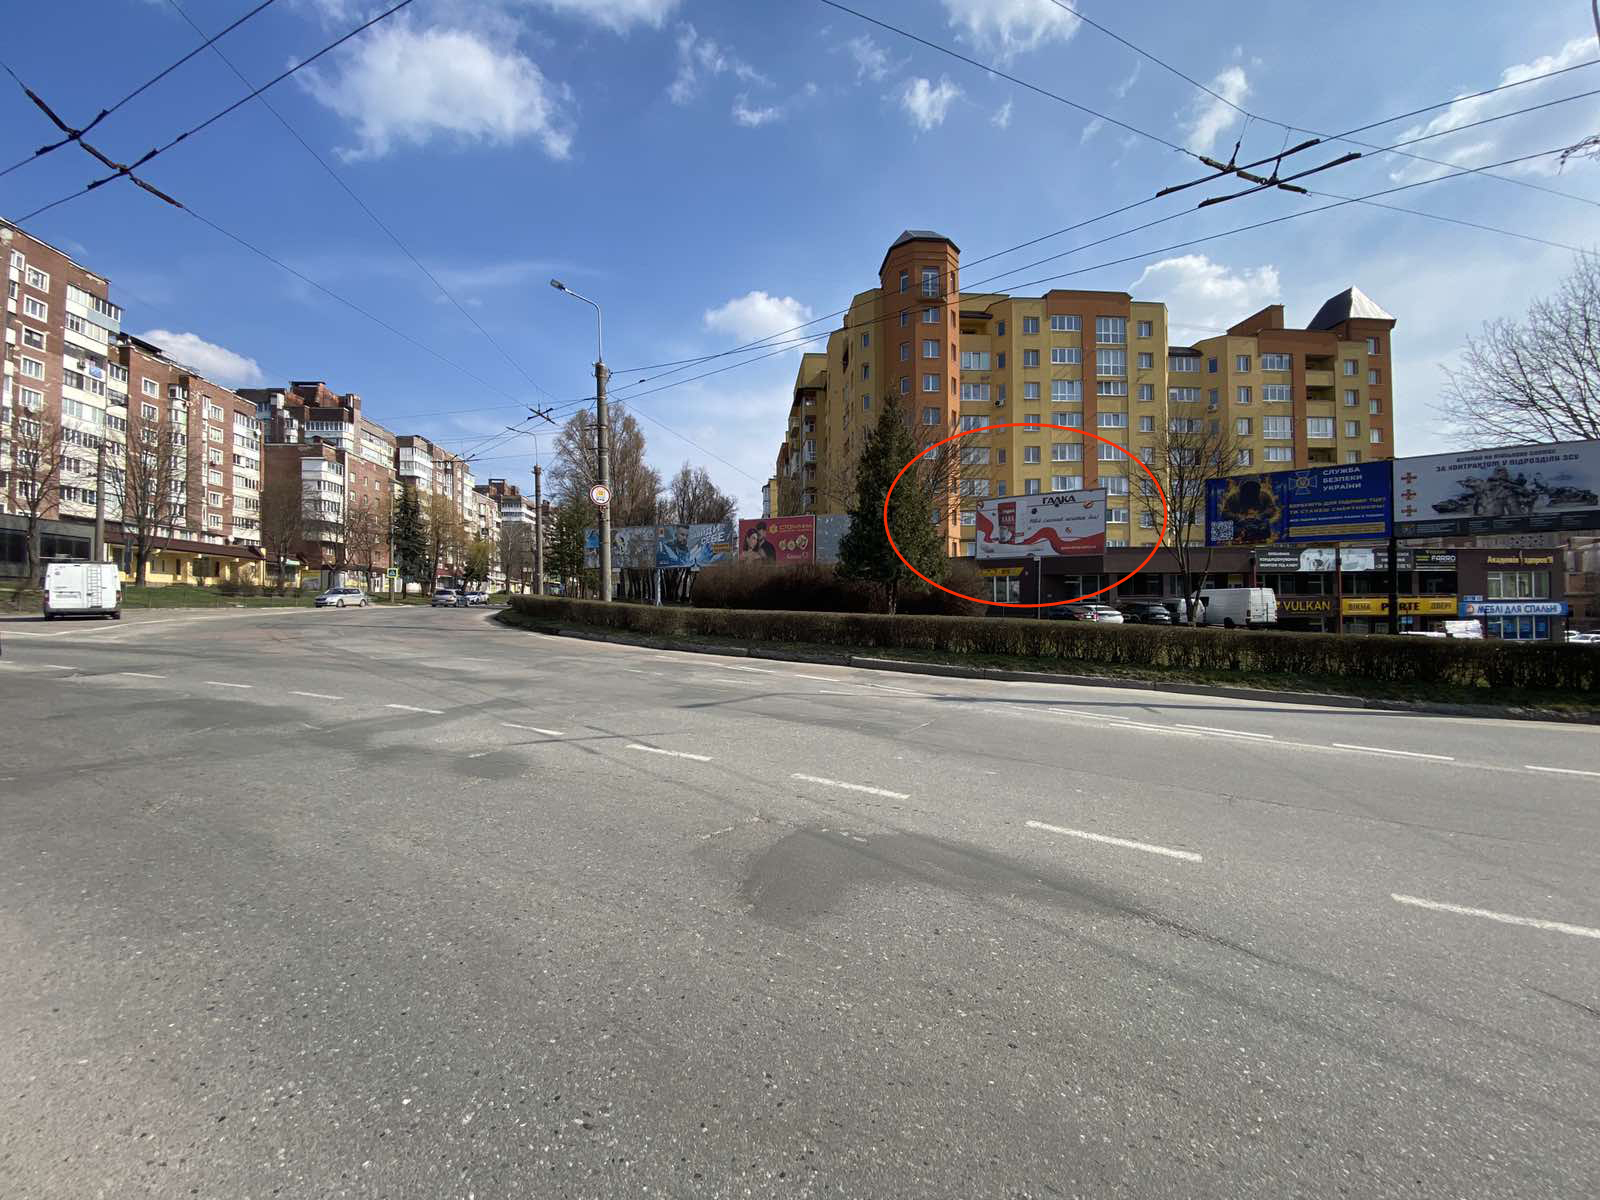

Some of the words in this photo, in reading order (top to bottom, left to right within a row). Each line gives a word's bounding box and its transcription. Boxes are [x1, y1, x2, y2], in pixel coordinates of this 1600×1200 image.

[1448, 461, 1501, 471] КОНТРАКТОМ
[1510, 456, 1561, 466] ПІДРОЗДІЛИ
[1323, 467, 1361, 476] СЛУЖБА
[1323, 475, 1363, 484] БЕЗПЕКИ
[1323, 482, 1362, 491] УКРАЇНИ
[1042, 495, 1076, 505] ГАЛКА
[1283, 601, 1331, 611] VULKAN
[1381, 602, 1420, 611] PRTE
[1477, 605, 1503, 613] МЕБЛІ
[1504, 605, 1521, 614] ДЛЯ
[1523, 604, 1557, 613] СПАЛЬНІ
